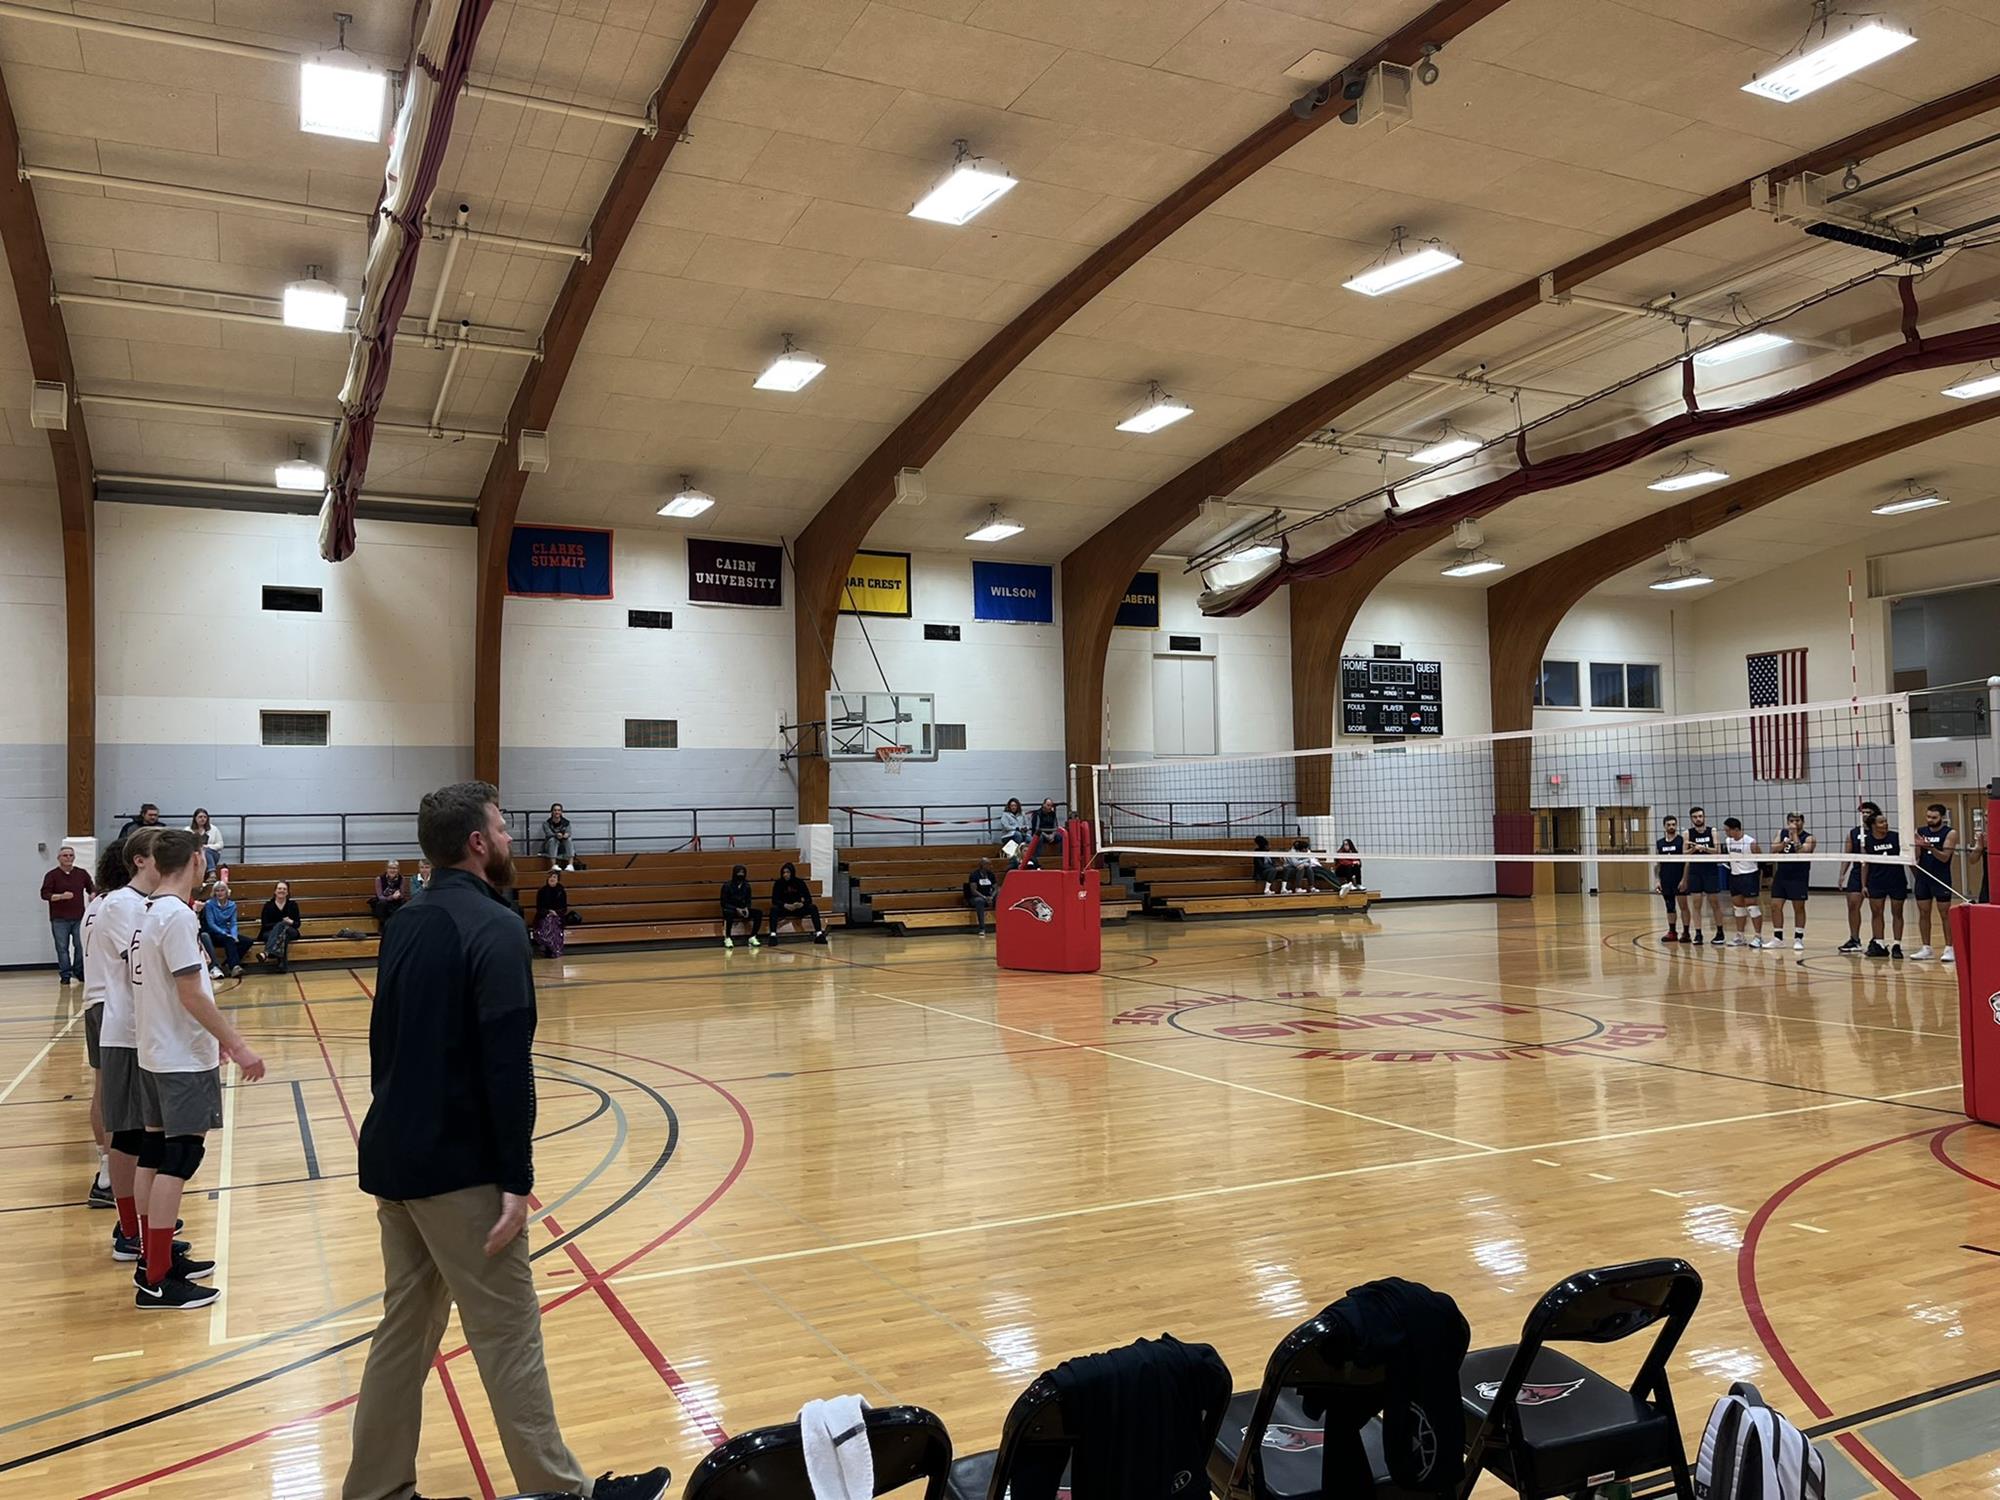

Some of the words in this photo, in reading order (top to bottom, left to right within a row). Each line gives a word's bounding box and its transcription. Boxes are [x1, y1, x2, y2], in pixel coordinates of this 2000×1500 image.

[532, 543, 585, 555] CLARKS
[531, 555, 586, 568] SUMMIT
[716, 558, 756, 572] CAIRN
[695, 572, 776, 589] UNIVERSITY
[867, 578, 902, 590] CREST
[990, 586, 1036, 599] WILSON
[1343, 661, 1368, 671] HOME
[1416, 663, 1439, 673] GUEST
[1347, 703, 1366, 711] FOULS
[1382, 704, 1404, 712] PLAYER
[1111, 994, 1249, 1026] HOUSE
[1213, 1003, 1534, 1040] LIONS
[1290, 1019, 1669, 1063] ASPLUNDH
